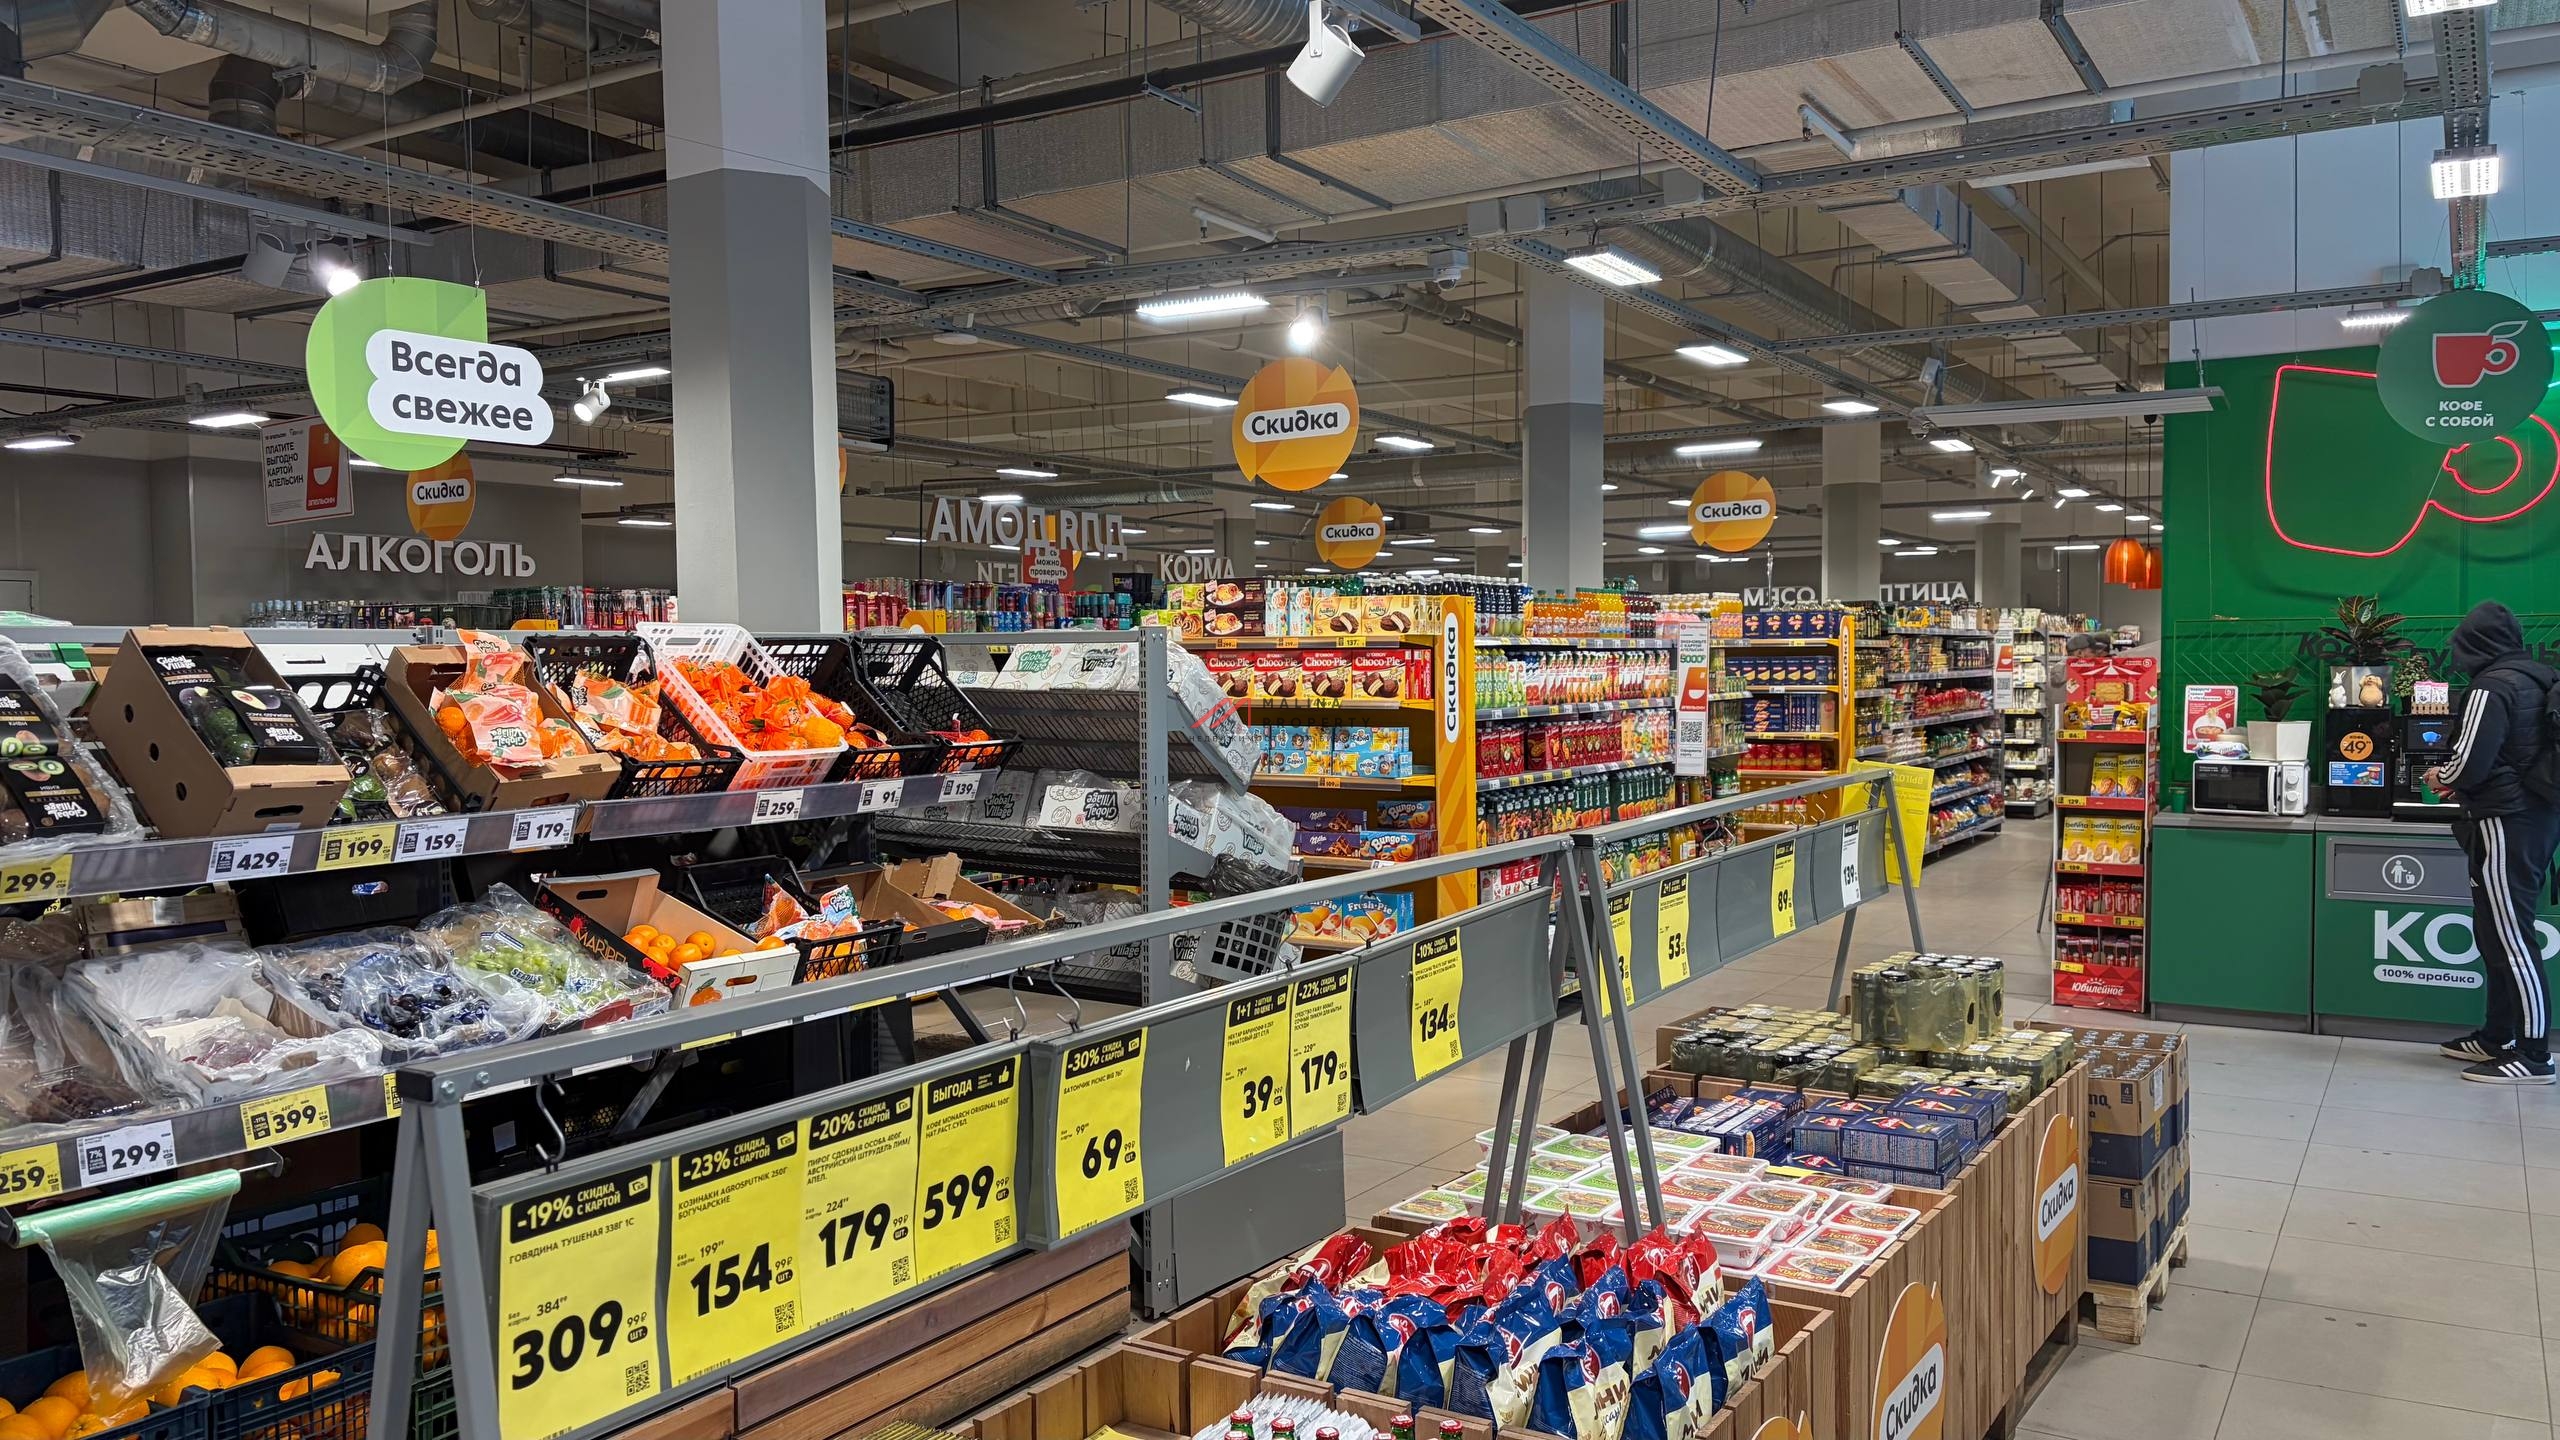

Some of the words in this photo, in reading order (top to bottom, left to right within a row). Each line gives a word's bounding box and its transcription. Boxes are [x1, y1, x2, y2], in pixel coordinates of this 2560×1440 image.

[391, 340, 522, 387] Всегда
[392, 393, 533, 431] свежее
[2439, 401, 2483, 411] КОФЕ
[1251, 407, 1339, 437] Скидка
[2425, 416, 2435, 427] С
[2439, 413, 2494, 427] СОБОЙ
[266, 442, 294, 454] ПЛАТИТЕ
[266, 453, 298, 466] ВЫГОДНО
[267, 464, 293, 477] КАРТОЙ
[268, 475, 304, 488] АПЕЛЬСИН
[417, 482, 464, 500] Скидка
[1702, 502, 1762, 519] Скидка
[1325, 524, 1374, 541] Скидка
[305, 533, 536, 577] АЛКОГОЛЬ
[1036, 559, 1060, 568] можно
[1030, 567, 1067, 578] проверить
[1160, 553, 1235, 582] КОРМА
[157, 655, 186, 664] Global
[163, 660, 196, 670] Village
[1019, 651, 1051, 664] Global
[1019, 658, 1047, 671] Village
[1447, 627, 1456, 732] Скидка
[2122, 717, 2137, 726] TUC
[265, 728, 299, 737] Village
[275, 734, 303, 742] Global
[491, 728, 524, 741] Village
[496, 736, 526, 747] Global
[2343, 742, 2367, 753] 49
[2095, 761, 2118, 769] belVita
[2119, 758, 2144, 768] belVita
[883, 790, 896, 803] 91
[955, 783, 972, 794] 139
[44, 802, 82, 812] Village
[1086, 790, 1118, 808] Village
[54, 809, 88, 820] Global
[770, 802, 794, 815] 259
[985, 805, 1013, 819] Village
[1086, 804, 1118, 820] Global
[1309, 811, 1327, 821] Milka
[1388, 804, 1416, 819] Bungo
[536, 823, 564, 839] 179
[2066, 822, 2089, 830] belVita
[2091, 822, 2114, 830] belVita
[2117, 823, 2141, 831] belVita
[347, 838, 383, 858] 199
[424, 833, 456, 851] 159
[1309, 835, 1327, 845] Milka
[1371, 836, 1400, 852] Bungo
[237, 852, 280, 870] 429
[6, 872, 56, 894] 299
[1844, 864, 1855, 886] 139
[1778, 889, 1789, 912] 89
[1110, 944, 1140, 958] Village
[1416, 943, 1434, 959] -10%
[1668, 933, 1681, 960] 53
[2381, 968, 2414, 980] 100%
[2417, 971, 2476, 985] арабика
[1299, 981, 1320, 1000] -22%
[2072, 982, 2124, 997] Юбилейное
[1236, 1002, 1251, 1022] 1+1
[1420, 1002, 1449, 1042] 134
[1067, 1049, 1100, 1072] -30%
[1102, 1040, 1121, 1054] СКИДКА
[1105, 1048, 1124, 1062] КАРТОЙ
[1300, 1051, 1337, 1093] 179
[932, 1080, 973, 1104] ВЫГОДА
[1063, 1081, 1090, 1095] БАТОНЧИК
[1243, 1076, 1274, 1119] 39
[274, 1105, 317, 1133] 399
[813, 1112, 856, 1141] -20%
[858, 1102, 887, 1118] СКИДКА
[863, 1110, 890, 1127] КАРТОЙ
[926, 1120, 941, 1131] КОФЕ
[941, 1110, 970, 1126] MONARCH
[971, 1103, 996, 1118] ORIGINAL
[89, 1148, 103, 1159] 7%
[111, 1142, 161, 1170] 299
[683, 1149, 731, 1180] -23%
[734, 1137, 766, 1154] СКИДКА
[740, 1145, 770, 1166] КАРТОЙ
[807, 1154, 857, 1176] АВСТРИЙСКИЙ
[857, 1143, 893, 1162] ШТРУДЕЛЬ
[893, 1136, 911, 1151] ЛИМ/
[808, 1154, 830, 1168] ПИРОГ
[831, 1144, 863, 1161] СДОБНАЯ
[864, 1137, 886, 1149] ОСОБА
[1082, 1129, 1123, 1179] 69
[0, 1167, 45, 1194] 259
[807, 1173, 827, 1185] АПЕЛ.
[678, 1190, 719, 1210] КОЗИНАКИ
[721, 1172, 769, 1200] AGROSPUTNIK
[923, 1165, 995, 1230] 599
[517, 1195, 574, 1230] -19%
[577, 1182, 615, 1202] СКИДКА
[577, 1205, 583, 1216] С
[585, 1191, 621, 1213] КАРТОЙ
[678, 1195, 731, 1220] БОГУЧАРСКИЕ
[2042, 1176, 2074, 1228] Скидка
[509, 1242, 559, 1264] ГОВЯДИНА
[561, 1228, 603, 1247] ТУШЕНАЯ
[605, 1221, 623, 1234] 338Г
[819, 1203, 891, 1268] 179
[691, 1242, 772, 1317] 154
[512, 1300, 623, 1391] 309
[1886, 1362, 1937, 1440] Скидка
